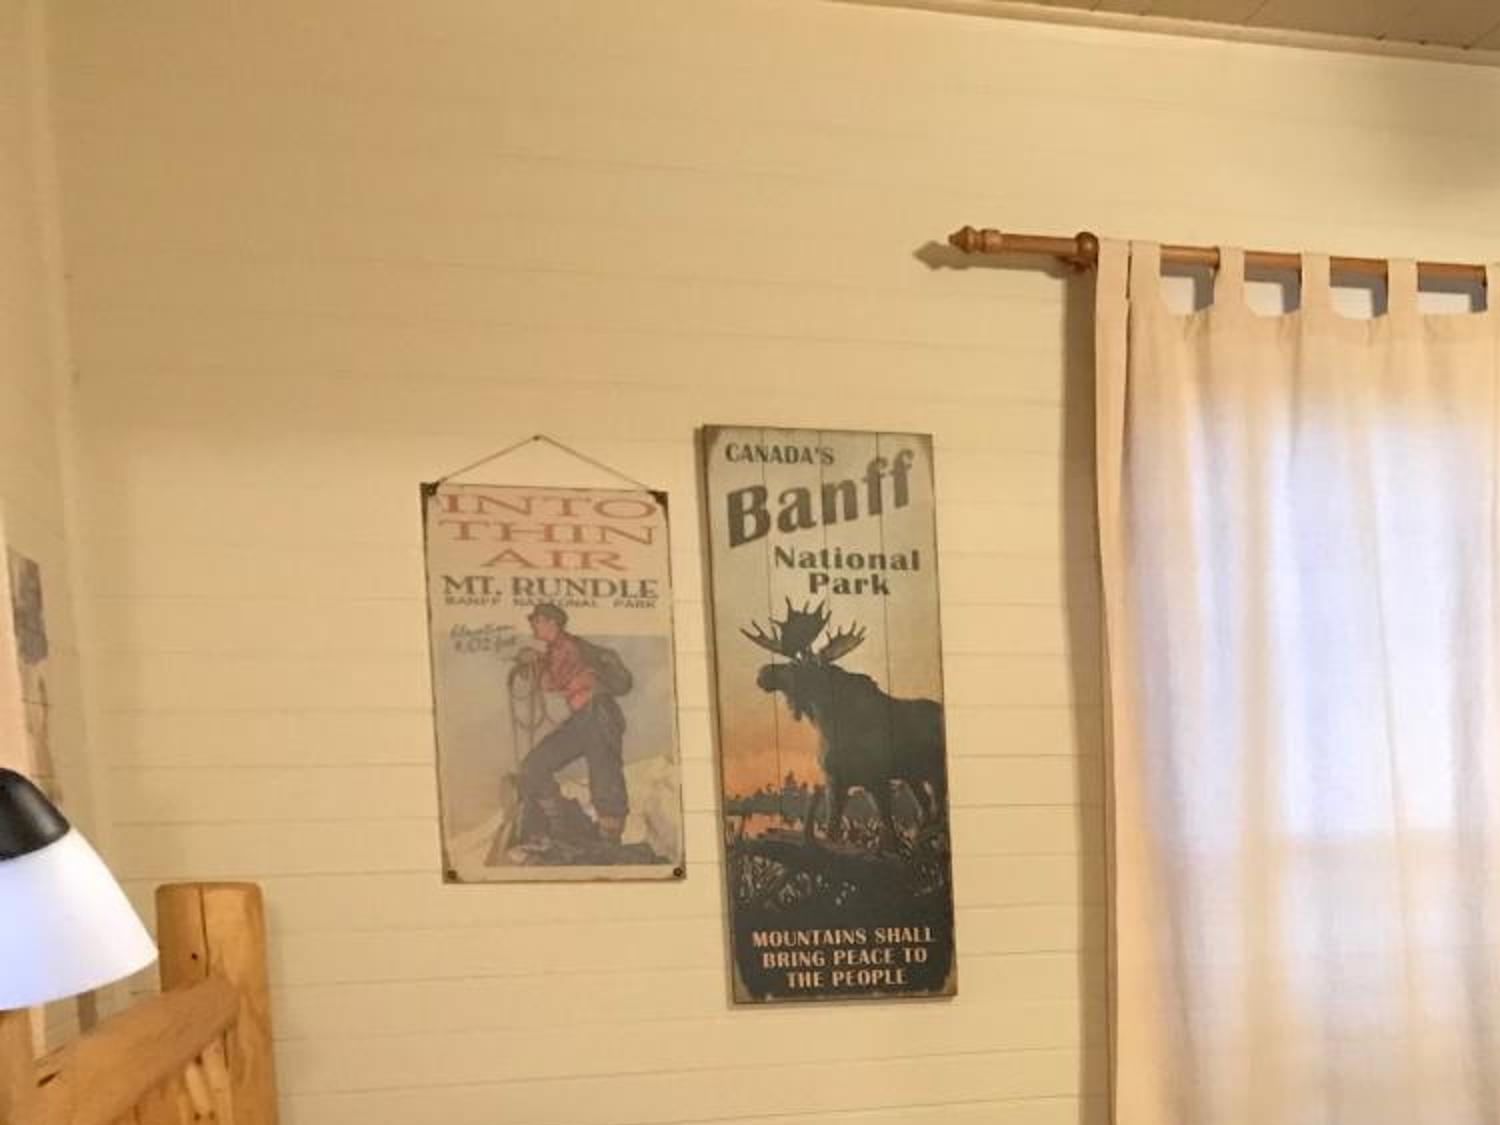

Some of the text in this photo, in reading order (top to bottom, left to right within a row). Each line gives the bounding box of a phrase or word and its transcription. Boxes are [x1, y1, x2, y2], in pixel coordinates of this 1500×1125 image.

[725, 443, 835, 465] CANADA'S
[440, 493, 658, 520] INTO
[727, 449, 914, 548] Banff
[438, 518, 658, 545] THIN
[480, 547, 631, 571] AIR
[774, 546, 920, 571] National
[441, 575, 659, 599] MT. RUNDLE
[808, 572, 890, 595] Park
[751, 927, 936, 948] MOUNTAINS SHALL
[762, 948, 928, 968] BRING PEACE TO
[786, 969, 909, 988] THE PEOPLE
